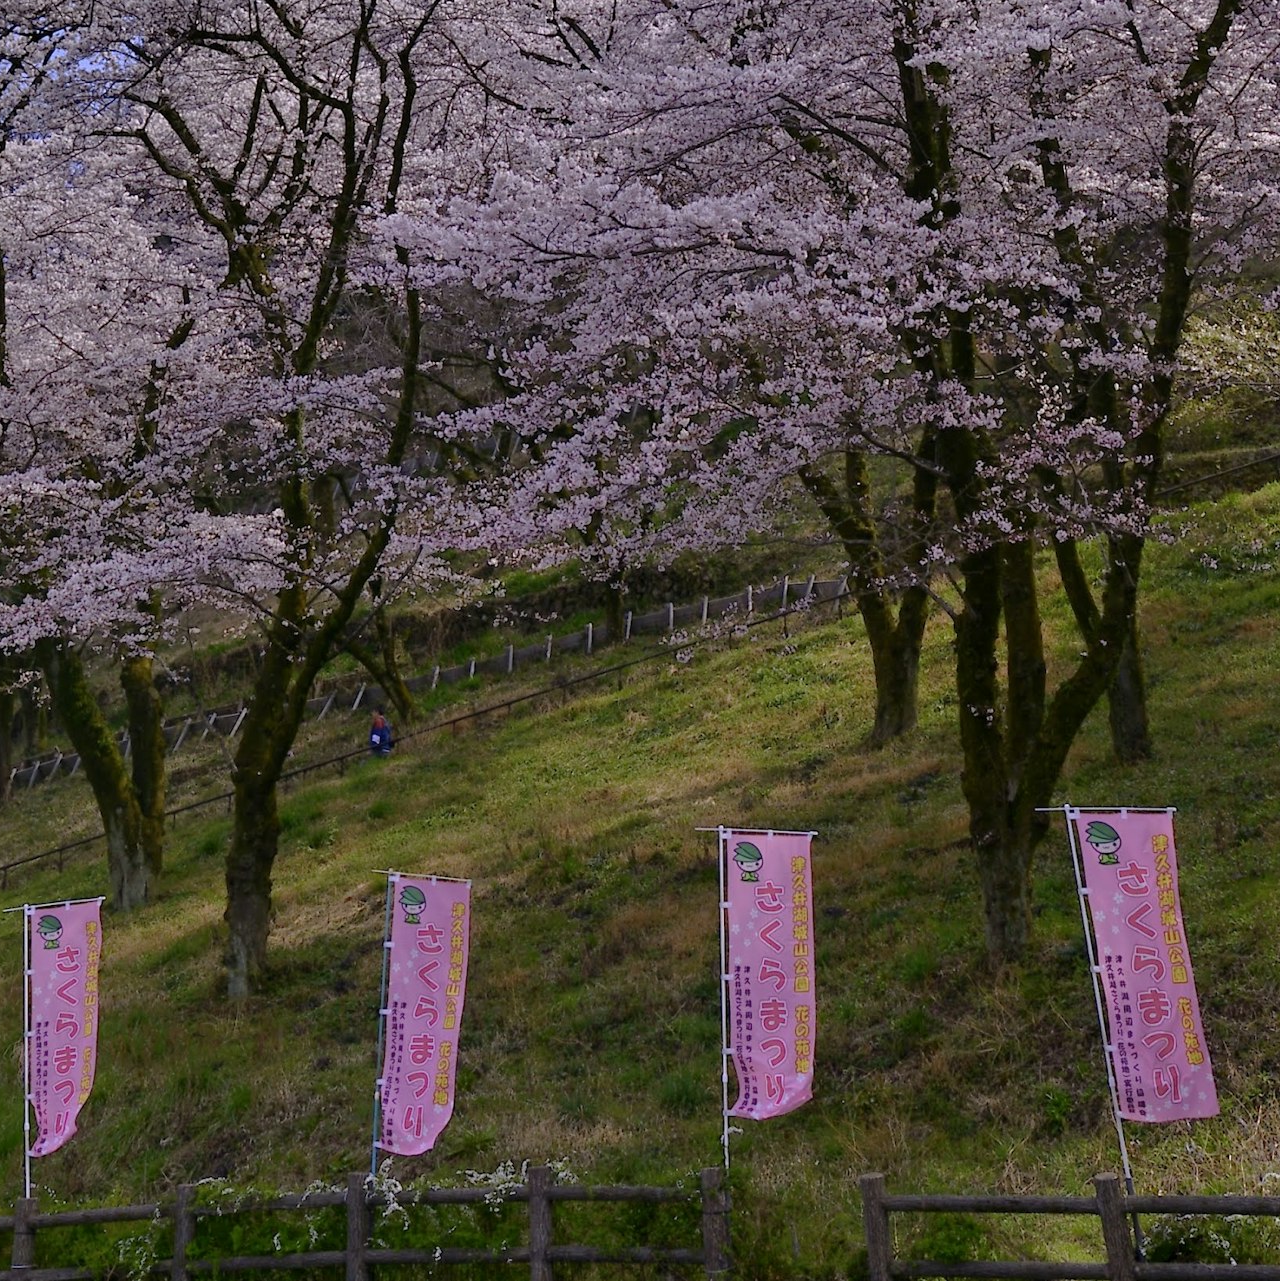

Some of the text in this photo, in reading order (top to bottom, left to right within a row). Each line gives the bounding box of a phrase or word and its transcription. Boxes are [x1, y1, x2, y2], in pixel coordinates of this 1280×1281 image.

[53, 946, 80, 1136] さくらまつり
[402, 923, 445, 1138] さくらまつり
[433, 902, 466, 1106] 津久井湖城山公園 花の苑地
[755, 880, 787, 1106] さくらまつり
[791, 856, 810, 1074] 津久井湖城山公園 花の苑地
[1116, 860, 1183, 1104] さくらまつり
[1151, 834, 1205, 1066] 津久井湖城山公園 花の苑地
